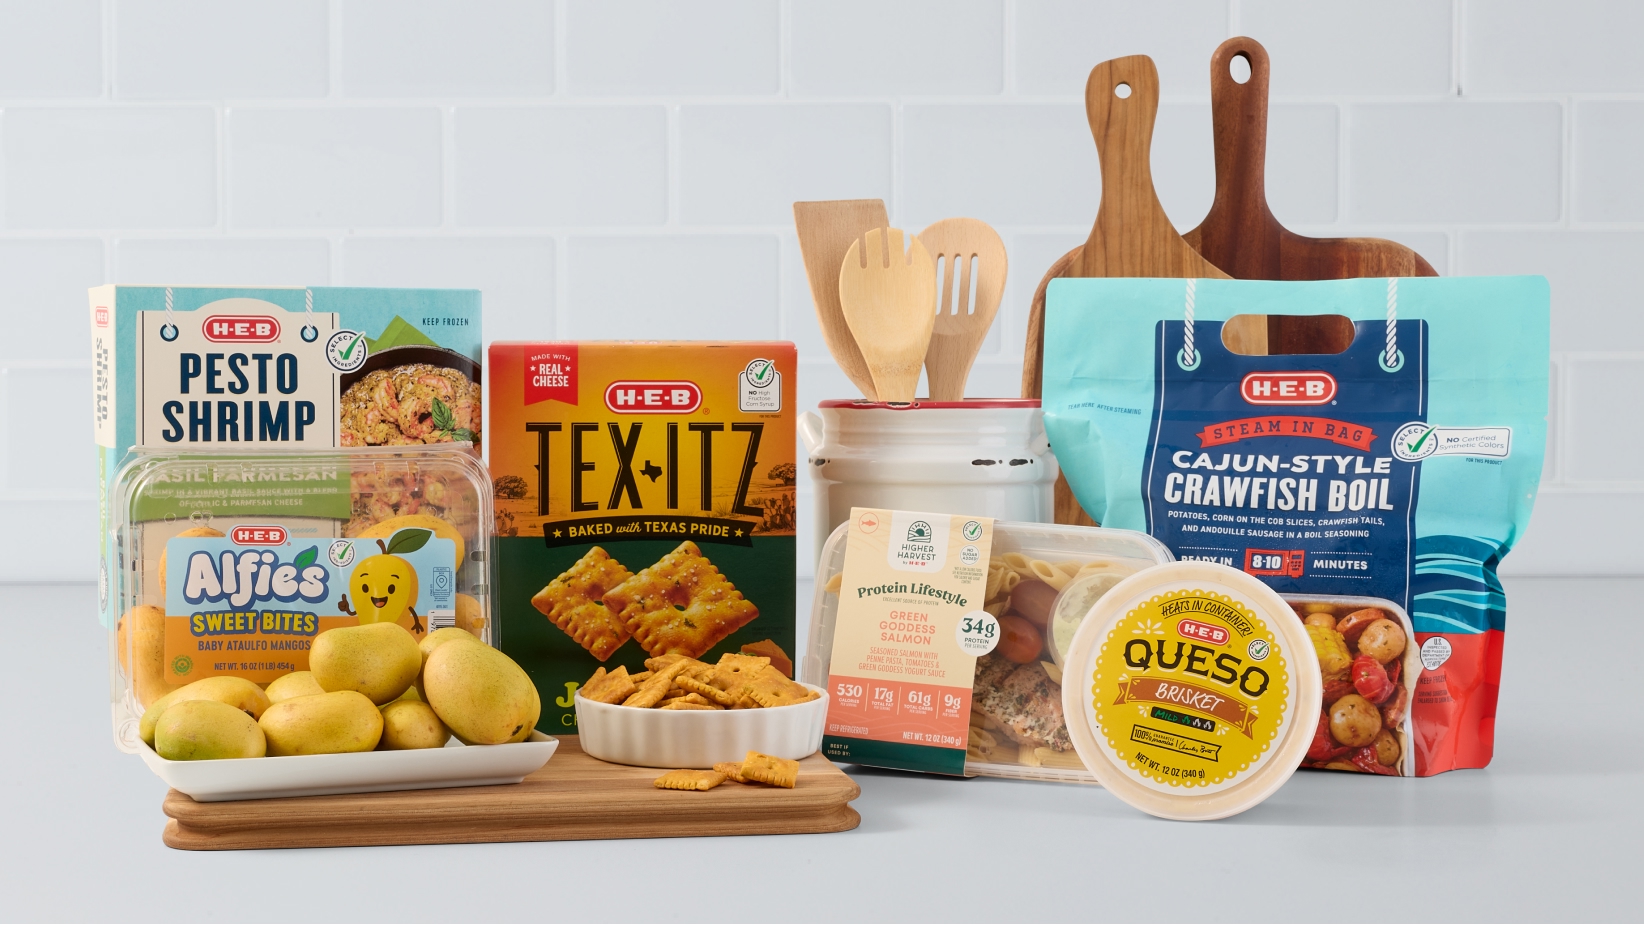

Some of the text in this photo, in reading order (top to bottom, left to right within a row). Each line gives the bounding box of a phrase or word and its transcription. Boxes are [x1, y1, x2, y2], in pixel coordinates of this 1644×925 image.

[422, 317, 469, 326] KEEP FROZEN
[213, 322, 271, 336] H-E-B
[330, 335, 353, 353] SELECT
[552, 354, 571, 362] WITH
[180, 352, 298, 395] PESTO
[539, 364, 563, 375] REAL
[532, 376, 570, 387] CHEESE
[1252, 380, 1326, 397] H-E-B
[616, 389, 691, 406] H-E-B
[1114, 407, 1142, 415] STEAMING
[162, 400, 316, 443] SHRIMP
[1213, 420, 1364, 442] STEAM IN BAG
[1398, 428, 1425, 446] SELECT
[1172, 450, 1393, 474] CAJUN-STYLE
[1164, 472, 1394, 512] CRAWFISH BOIL
[1168, 510, 1386, 528] POTATOES, CORN ON THE COB SLICES, CRAWFISH TAILS,
[238, 530, 282, 541] H-E-B
[568, 522, 730, 538] BAKED with TEXAS PRIDE
[1200, 526, 1246, 536] ANDOUILLE
[1246, 529, 1284, 539] SAUSAGE
[1286, 531, 1295, 539] IN
[1304, 531, 1323, 539] BOIL
[1324, 530, 1370, 538] SEASONING
[902, 544, 934, 553] HIGHER
[897, 551, 936, 561] HARVEST
[1220, 557, 1233, 566] IN
[1252, 554, 1282, 569] 8-10
[1313, 559, 1368, 570] MINUTES
[857, 582, 968, 608] Protein Lifestyle
[192, 612, 316, 633] SWEET BITES
[890, 610, 928, 622] GREEN
[1161, 600, 1254, 638] HEATS IN CONTAINER!
[879, 620, 936, 634] GODDESS
[961, 617, 996, 638] 34g
[1184, 624, 1224, 641] H-E-B
[198, 640, 311, 651] BABY ATAULFO MANGOS
[880, 632, 932, 646] SALMON
[870, 646, 938, 660] SEASONED SALMON WITH
[214, 662, 226, 670] NET
[227, 662, 239, 671] WT.
[240, 662, 248, 670] 16
[250, 662, 258, 670] OZ
[258, 662, 264, 672] (1
[265, 662, 276, 672] LB)
[276, 662, 290, 670] 454
[866, 655, 885, 664] PENNE
[886, 656, 904, 666] PASTA,
[905, 658, 935, 668] TOMATOES
[1123, 638, 1270, 698] QUESO
[858, 662, 946, 678] GREEN GODDESS YOGURT SAUCE
[837, 683, 962, 710] 530 17g 61g 9g
[1155, 682, 1225, 712] BRISKET
[1154, 709, 1178, 722] MILD
[829, 724, 869, 735] KEEP REFRIGERATED
[1134, 728, 1152, 741] 100%
[903, 732, 962, 746] NET WT. 12 OZ (340 g)
[1135, 752, 1206, 779] NET WT. 12 OZ (340 g)
